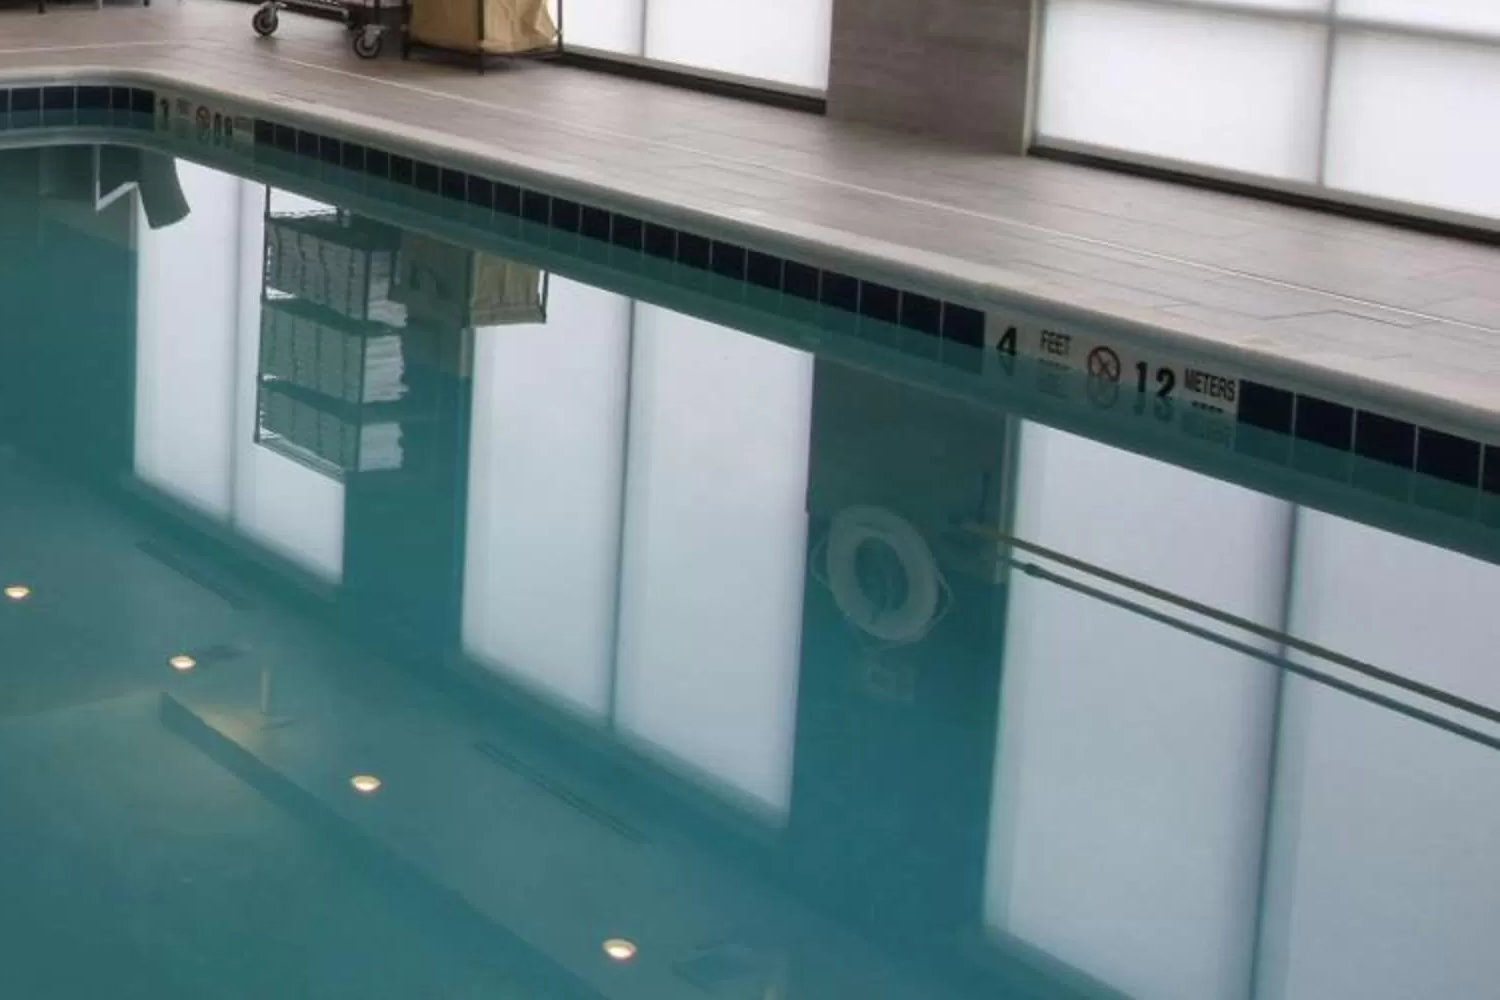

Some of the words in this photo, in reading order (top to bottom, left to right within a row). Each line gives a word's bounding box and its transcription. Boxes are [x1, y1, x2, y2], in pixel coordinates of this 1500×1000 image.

[996, 325, 1017, 356] 4
[1040, 330, 1071, 355] FEET
[1184, 367, 1236, 402] METERS
